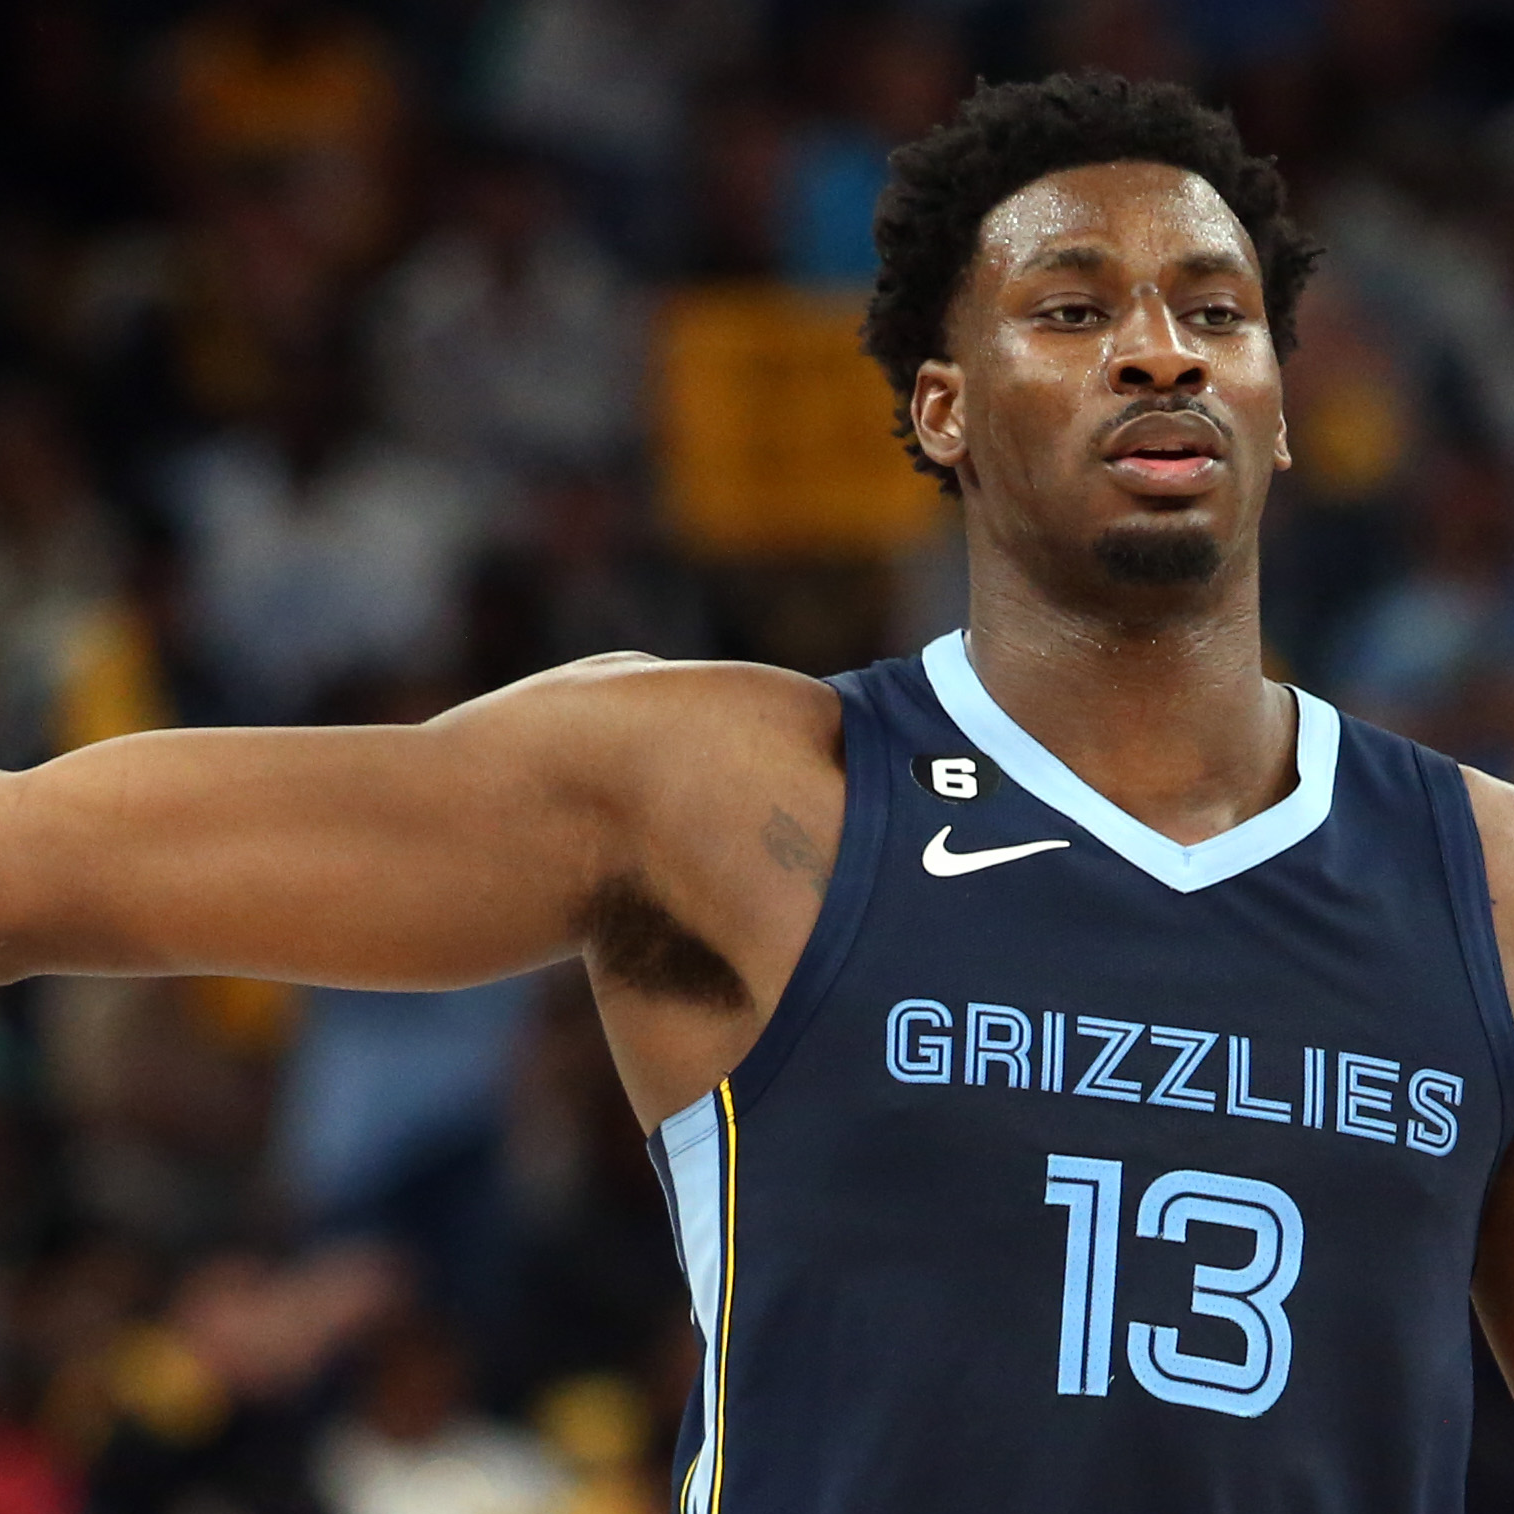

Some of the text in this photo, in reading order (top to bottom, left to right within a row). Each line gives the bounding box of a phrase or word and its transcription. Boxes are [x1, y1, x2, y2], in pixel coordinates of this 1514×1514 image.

[931, 758, 978, 799] 6
[887, 999, 1464, 1157] GRIZZLIES
[1045, 1154, 1304, 1418] 13
